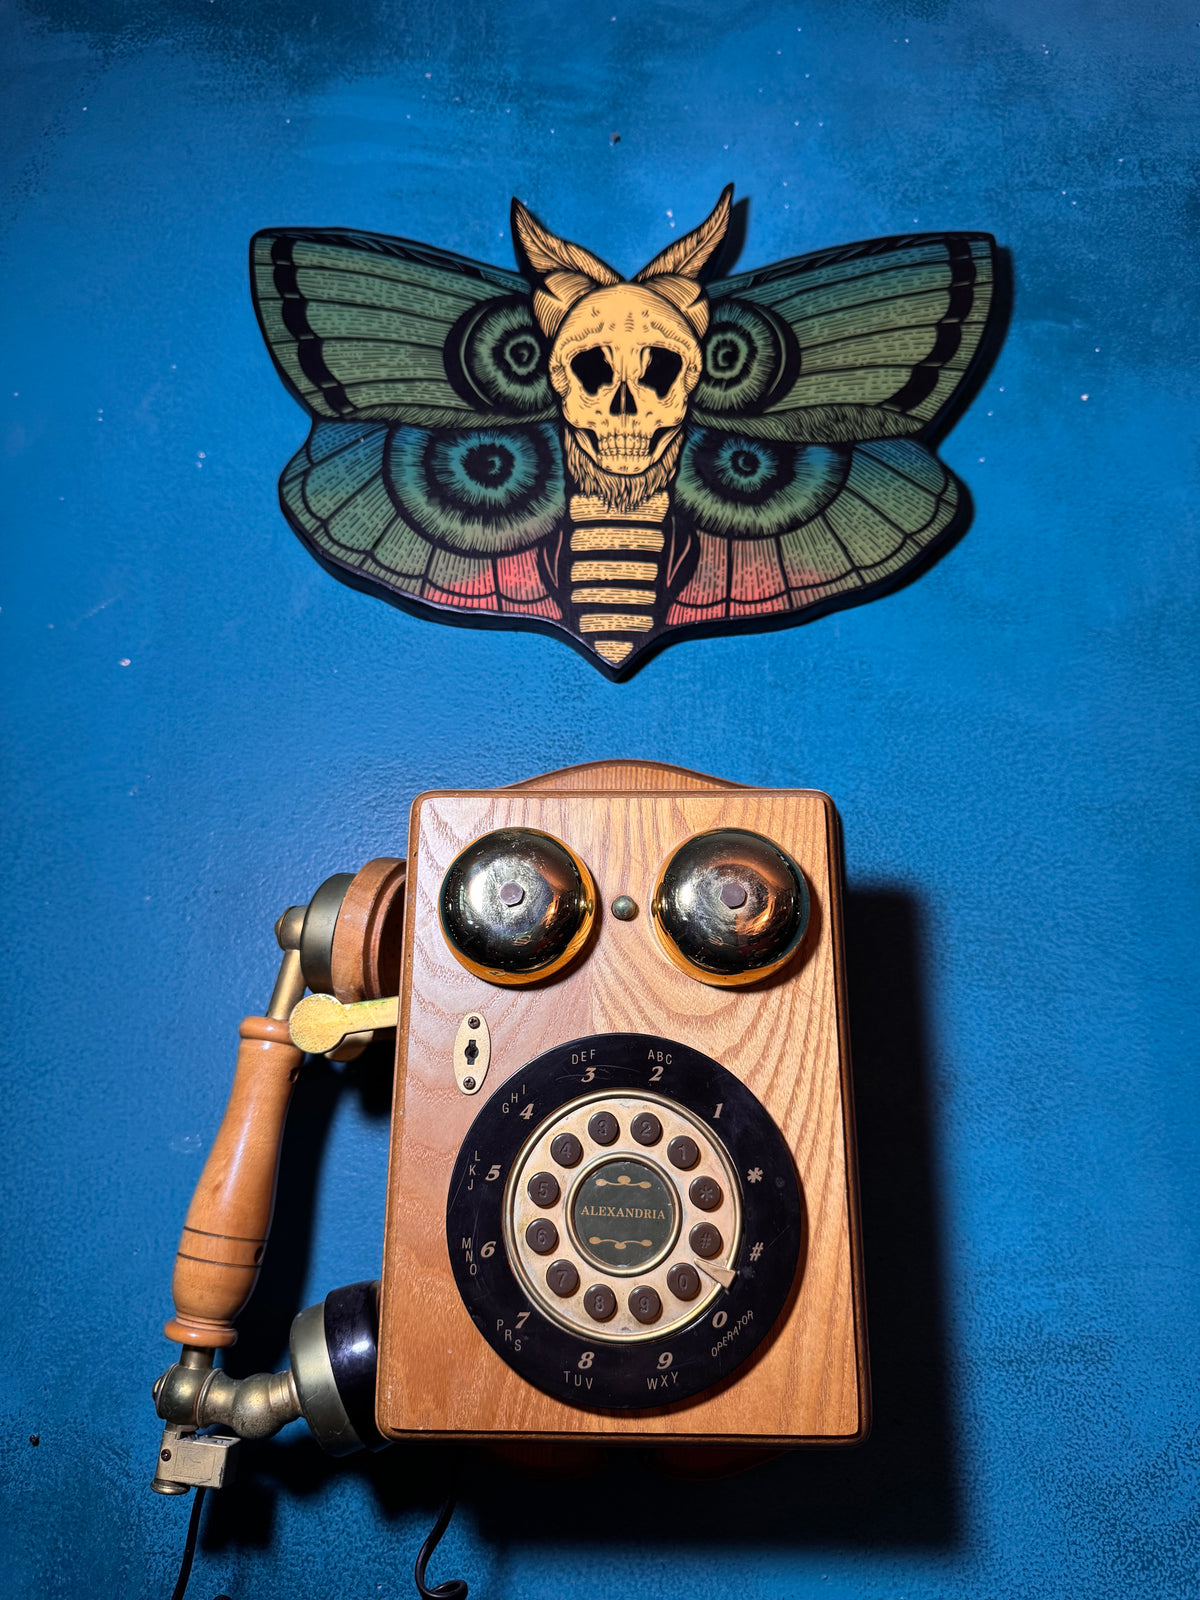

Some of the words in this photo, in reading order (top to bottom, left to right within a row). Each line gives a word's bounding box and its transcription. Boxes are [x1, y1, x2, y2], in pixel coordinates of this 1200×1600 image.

[571, 1049, 596, 1065] DEF
[647, 1049, 673, 1065] ABC
[581, 1067, 596, 1083] 3
[649, 1066, 664, 1082] 2
[502, 1084, 526, 1114] GHI
[519, 1103, 534, 1120] 4
[713, 1103, 724, 1119] 1
[485, 1165, 501, 1181] 5
[580, 1205, 666, 1220] ALEXANDRIA
[480, 1241, 497, 1258] 6
[515, 1311, 531, 1329] 7
[711, 1310, 754, 1357] OPERATOR
[578, 1351, 595, 1369] 8
[656, 1351, 673, 1370] 9
[563, 1371, 594, 1390] TUV
[647, 1371, 679, 1390] WXY
